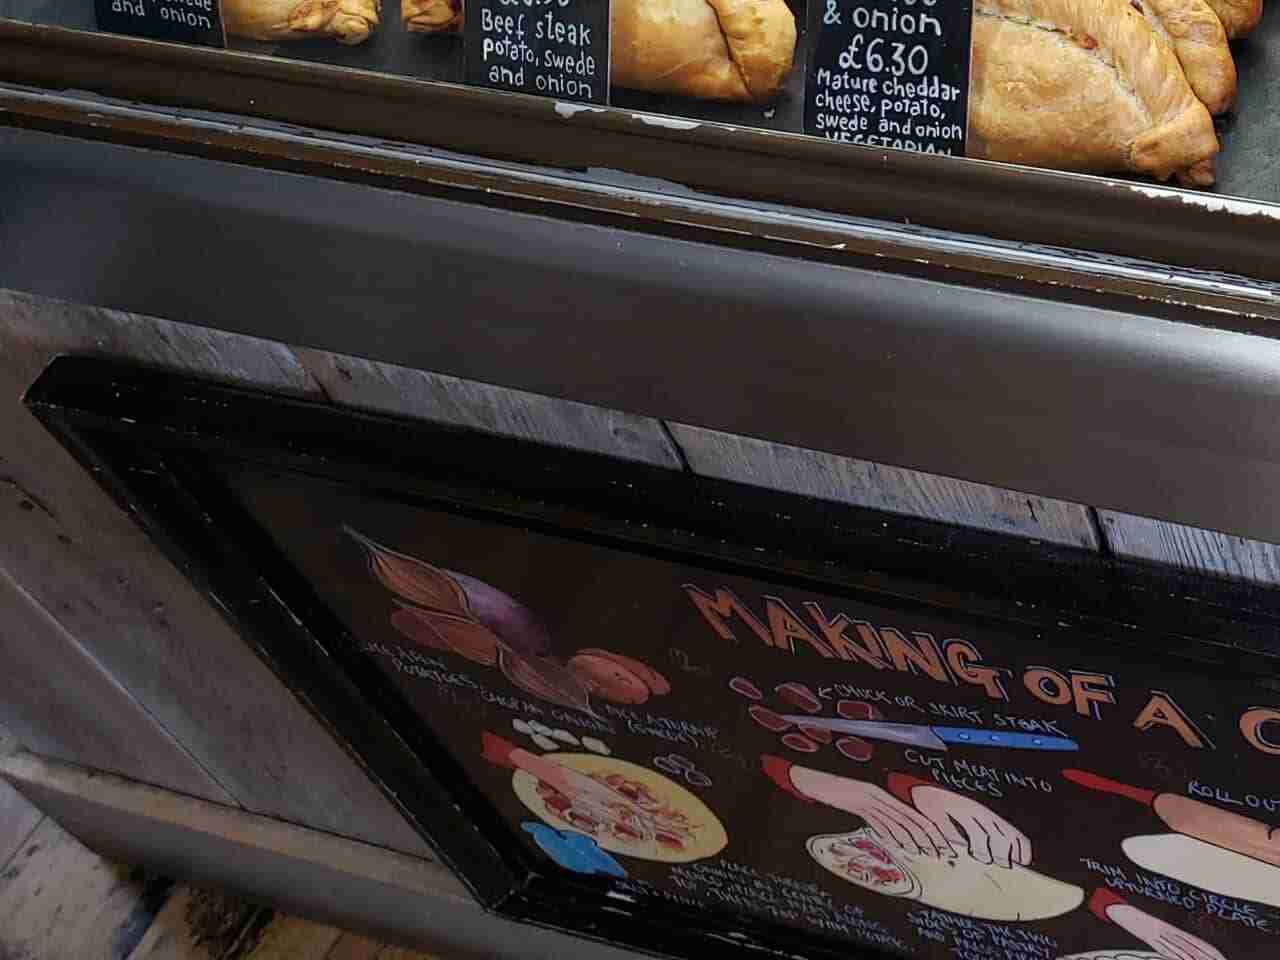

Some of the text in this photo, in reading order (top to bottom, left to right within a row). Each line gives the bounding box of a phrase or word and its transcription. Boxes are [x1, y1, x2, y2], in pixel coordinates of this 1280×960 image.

[160, 7, 211, 29] onion
[481, 8, 591, 46] Beef steak
[823, 0, 942, 36] & onion
[483, 37, 539, 66] potato,
[838, 33, 929, 76] £6.30
[488, 65, 592, 98] and onion
[817, 68, 961, 101] Mature cheddar
[816, 90, 946, 120] cheese, potato,
[816, 113, 963, 141] swede and onion
[681, 583, 1014, 703] MAKING
[1023, 664, 1118, 720] OF
[1133, 690, 1216, 749] A
[928, 702, 984, 725] SKIRT
[904, 748, 1055, 793] CUT MEAT INTO
[1187, 780, 1244, 807] ROLL
[1080, 857, 1127, 881] TRIM
[1136, 871, 1181, 895] INTO
[1188, 890, 1257, 916] CIRCLE
